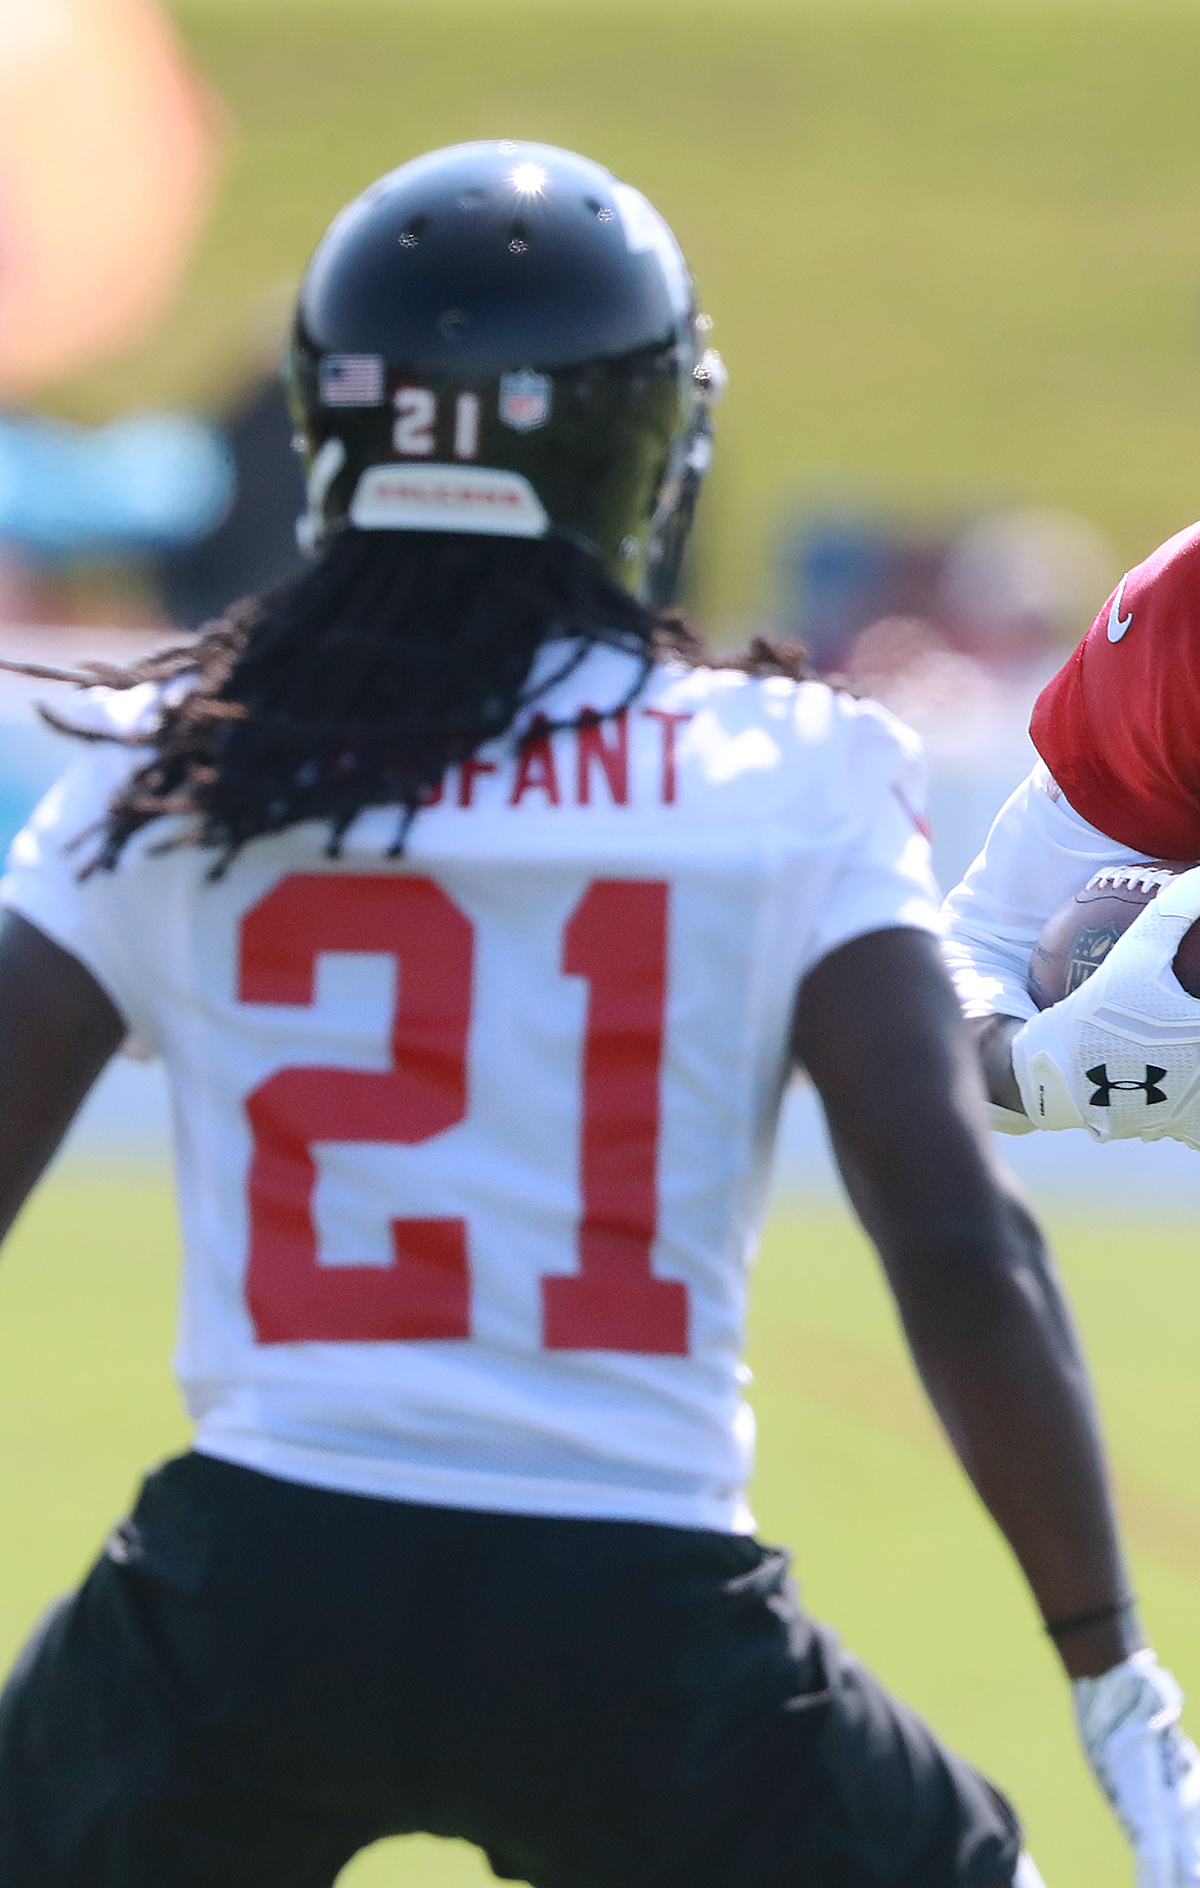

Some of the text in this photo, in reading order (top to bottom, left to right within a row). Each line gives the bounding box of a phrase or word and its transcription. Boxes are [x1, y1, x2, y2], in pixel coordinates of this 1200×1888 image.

[393, 386, 480, 460] 21
[424, 706, 693, 808] FANT
[236, 872, 691, 1358] 21
